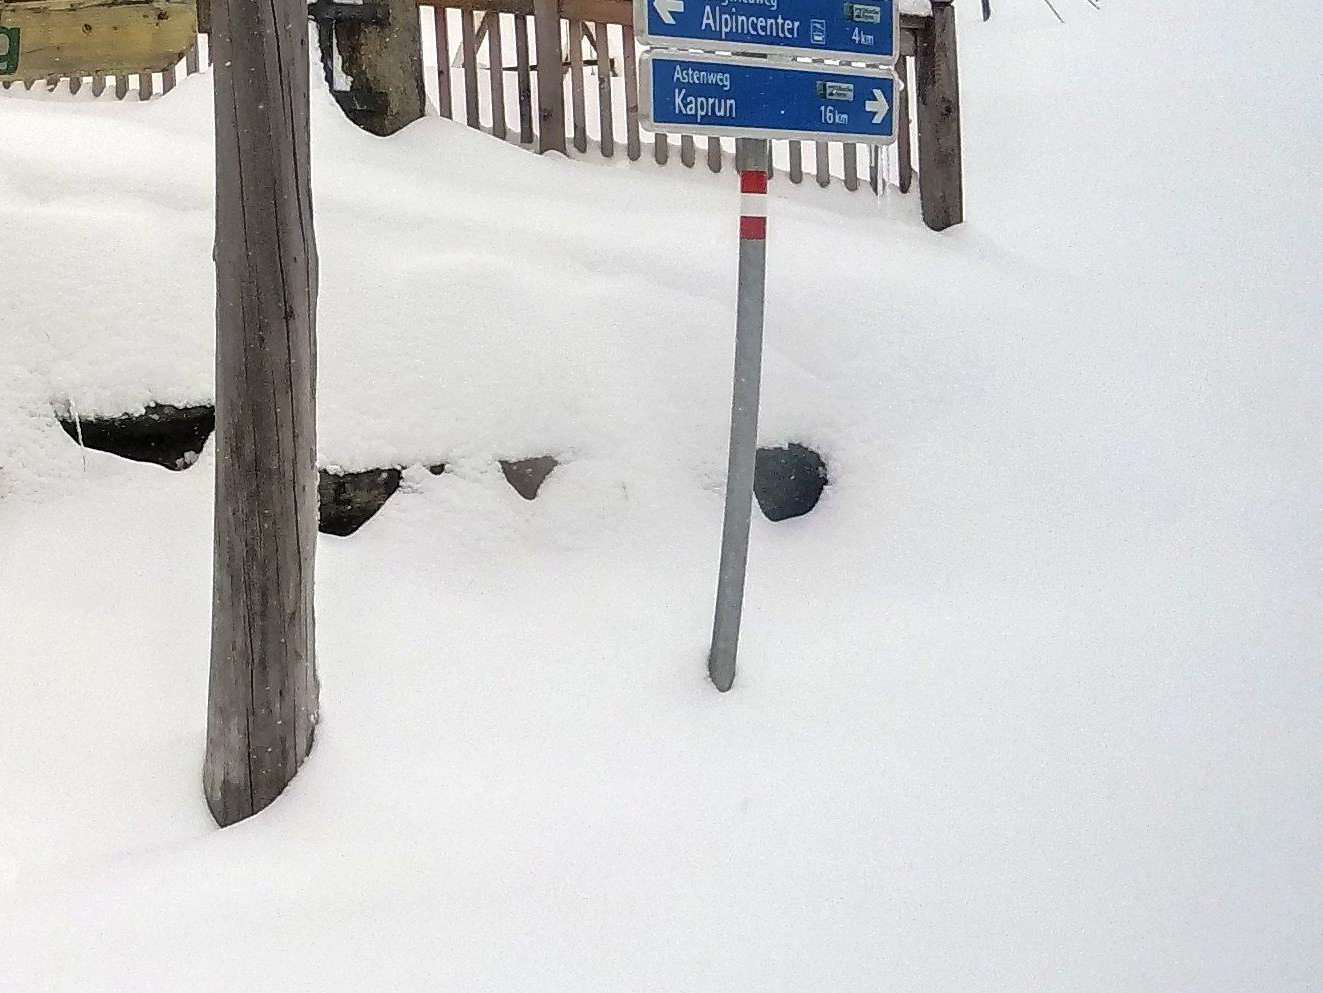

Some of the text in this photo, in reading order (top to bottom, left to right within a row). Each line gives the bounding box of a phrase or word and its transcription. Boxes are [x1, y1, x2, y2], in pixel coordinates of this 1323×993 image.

[701, 4, 800, 39] Alpincenter
[674, 65, 730, 90] Astenweg
[674, 88, 736, 122] Kaprun
